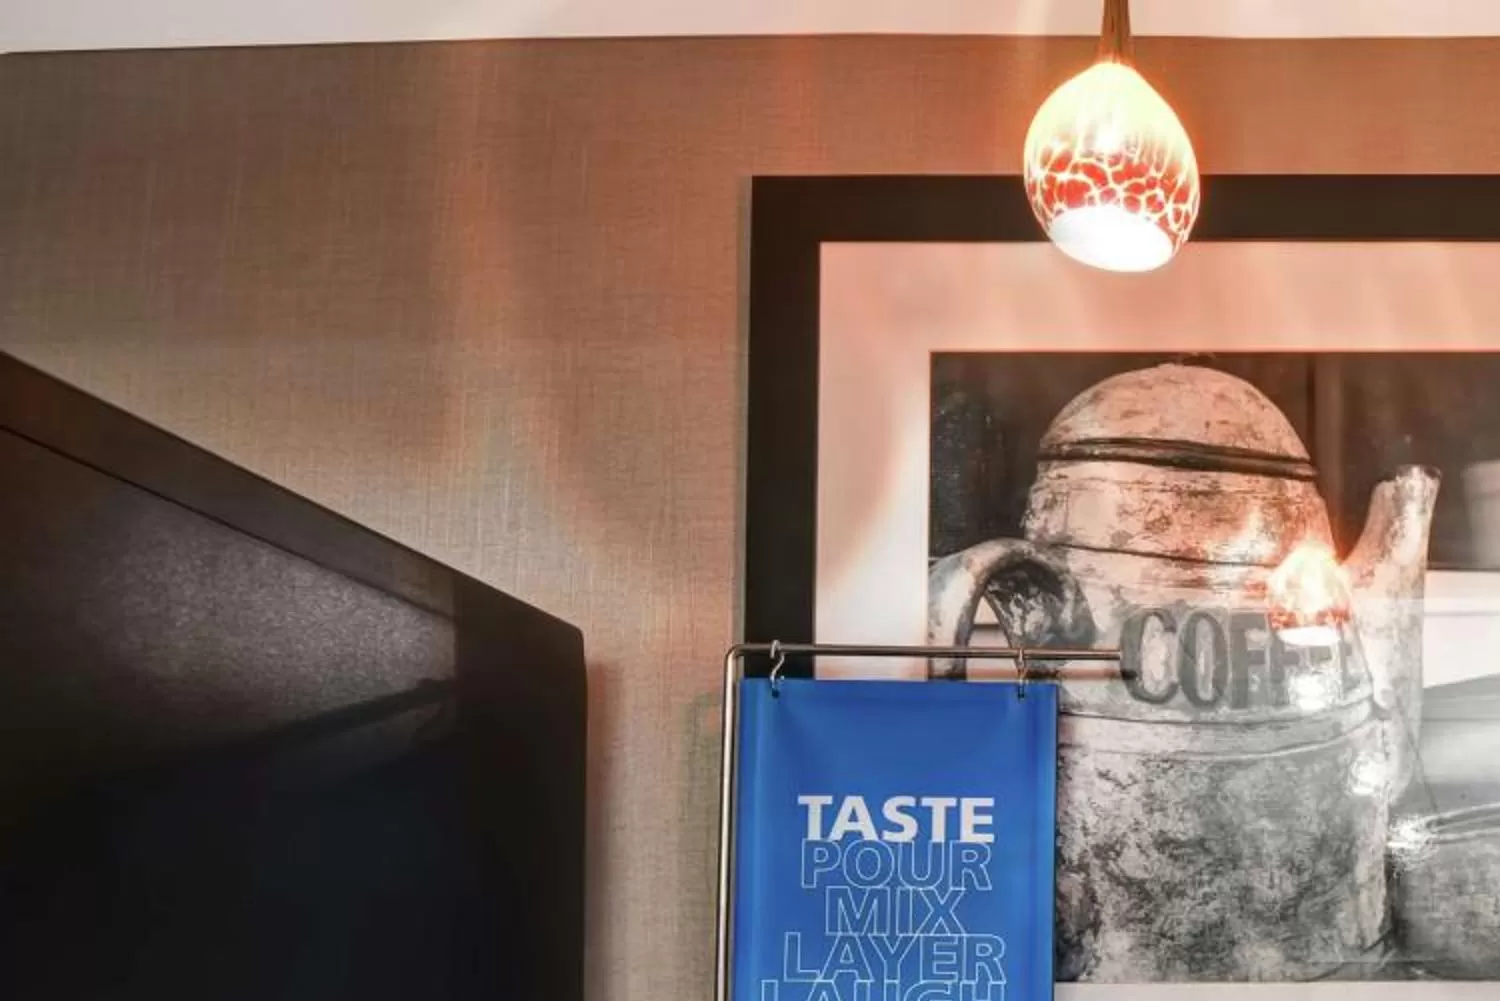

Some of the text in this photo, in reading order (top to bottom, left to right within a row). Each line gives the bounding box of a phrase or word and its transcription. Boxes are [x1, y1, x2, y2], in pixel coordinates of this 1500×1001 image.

[797, 795, 996, 843] TASTE
[801, 839, 993, 890] POUR
[825, 886, 967, 936] MIX
[783, 932, 1007, 984] LAYER
